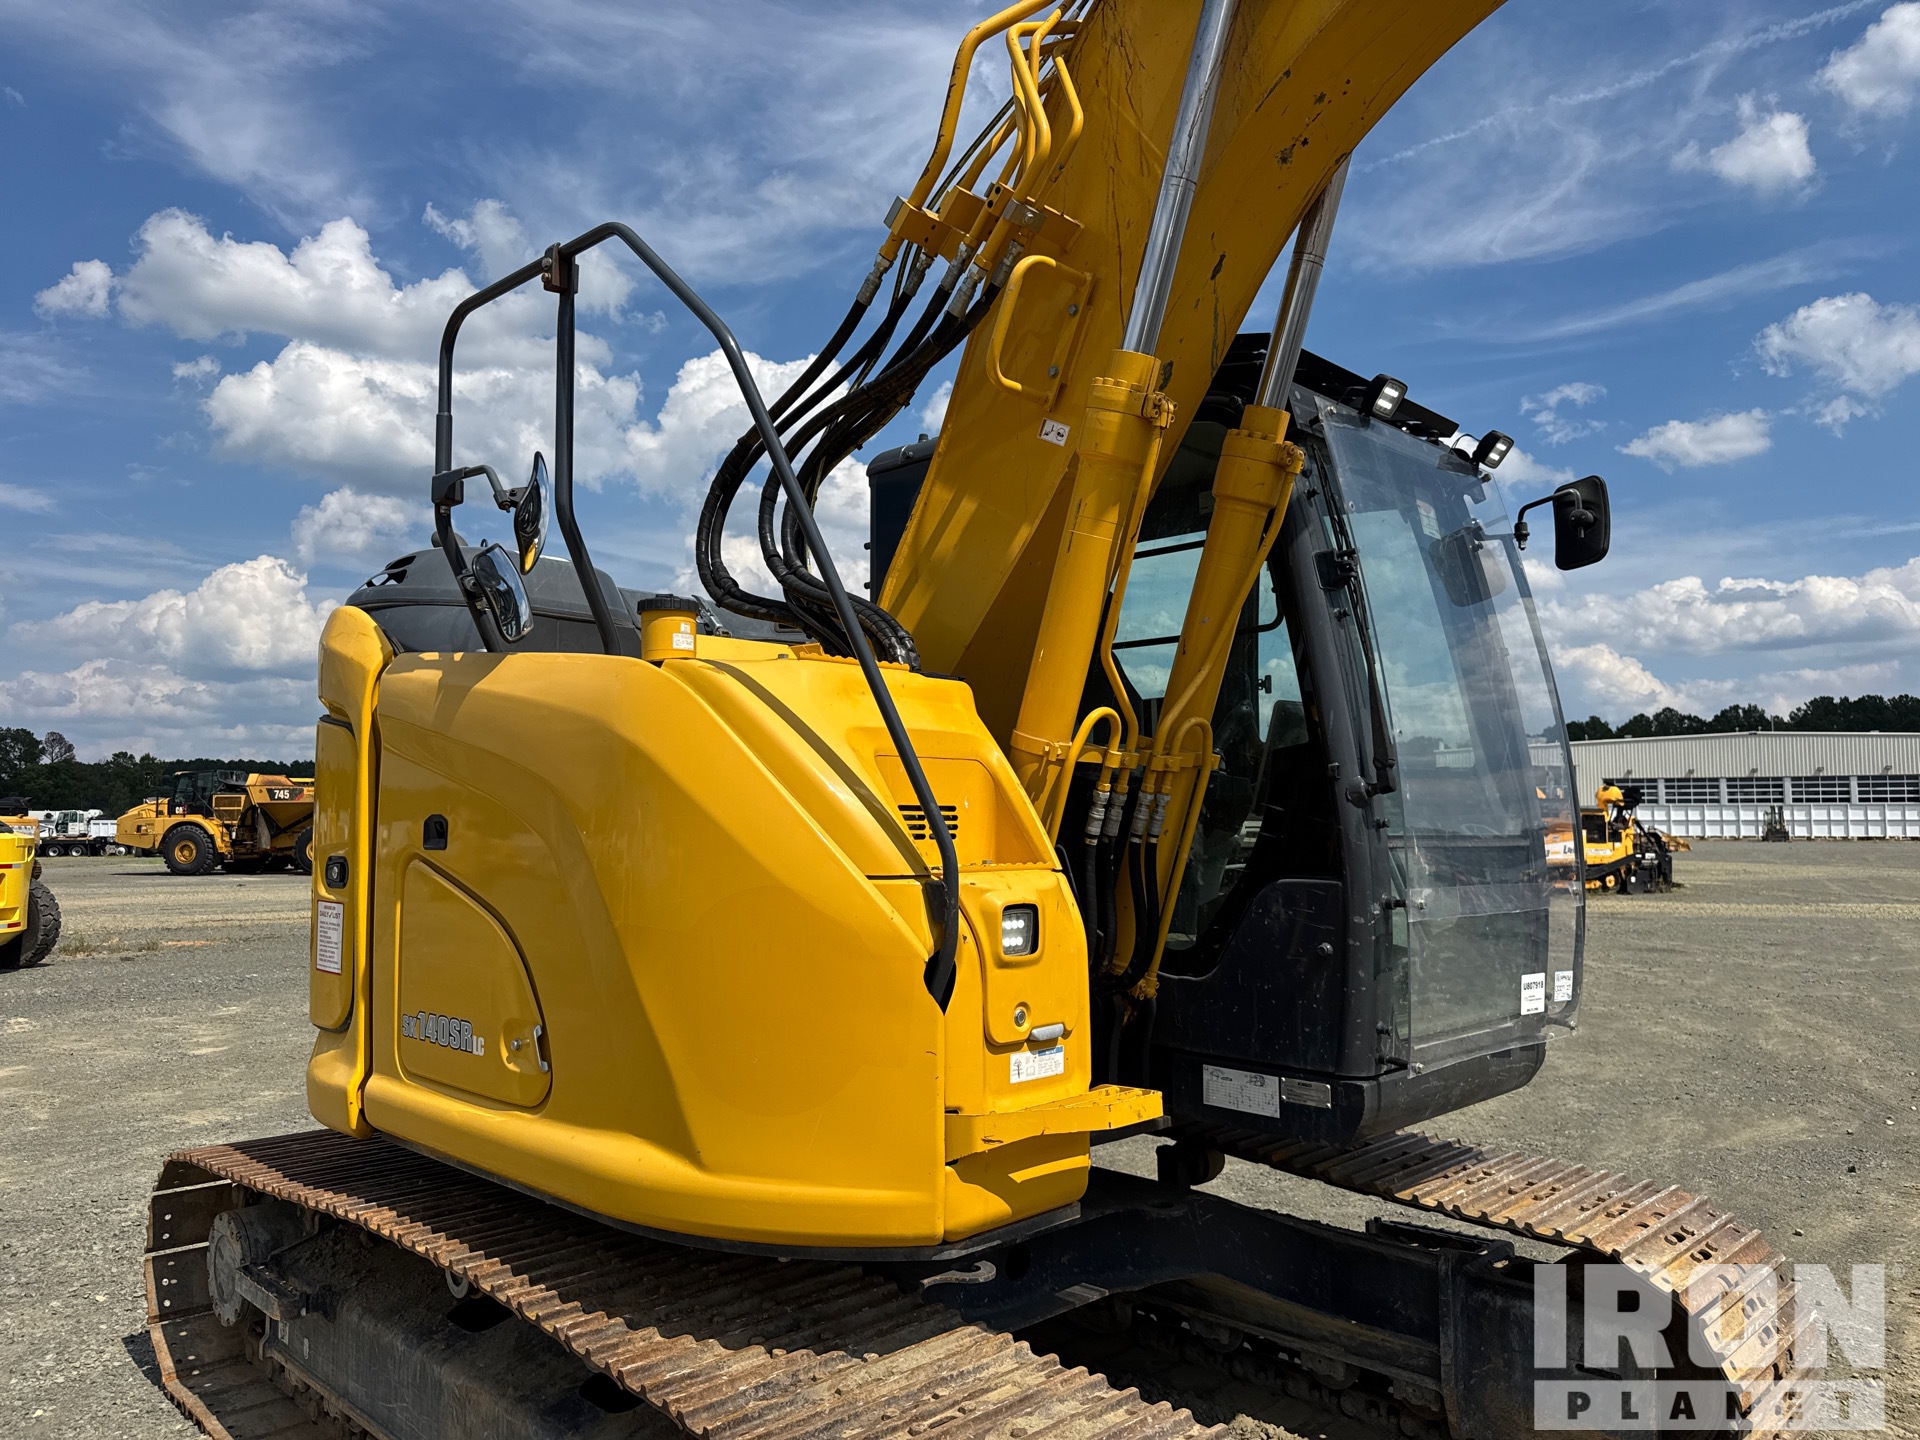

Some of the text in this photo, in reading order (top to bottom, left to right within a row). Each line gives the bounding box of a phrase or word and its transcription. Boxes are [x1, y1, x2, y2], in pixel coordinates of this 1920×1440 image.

[274, 790, 290, 799] 745
[320, 910, 329, 918] DAILY
[1523, 981, 1544, 991] U807918
